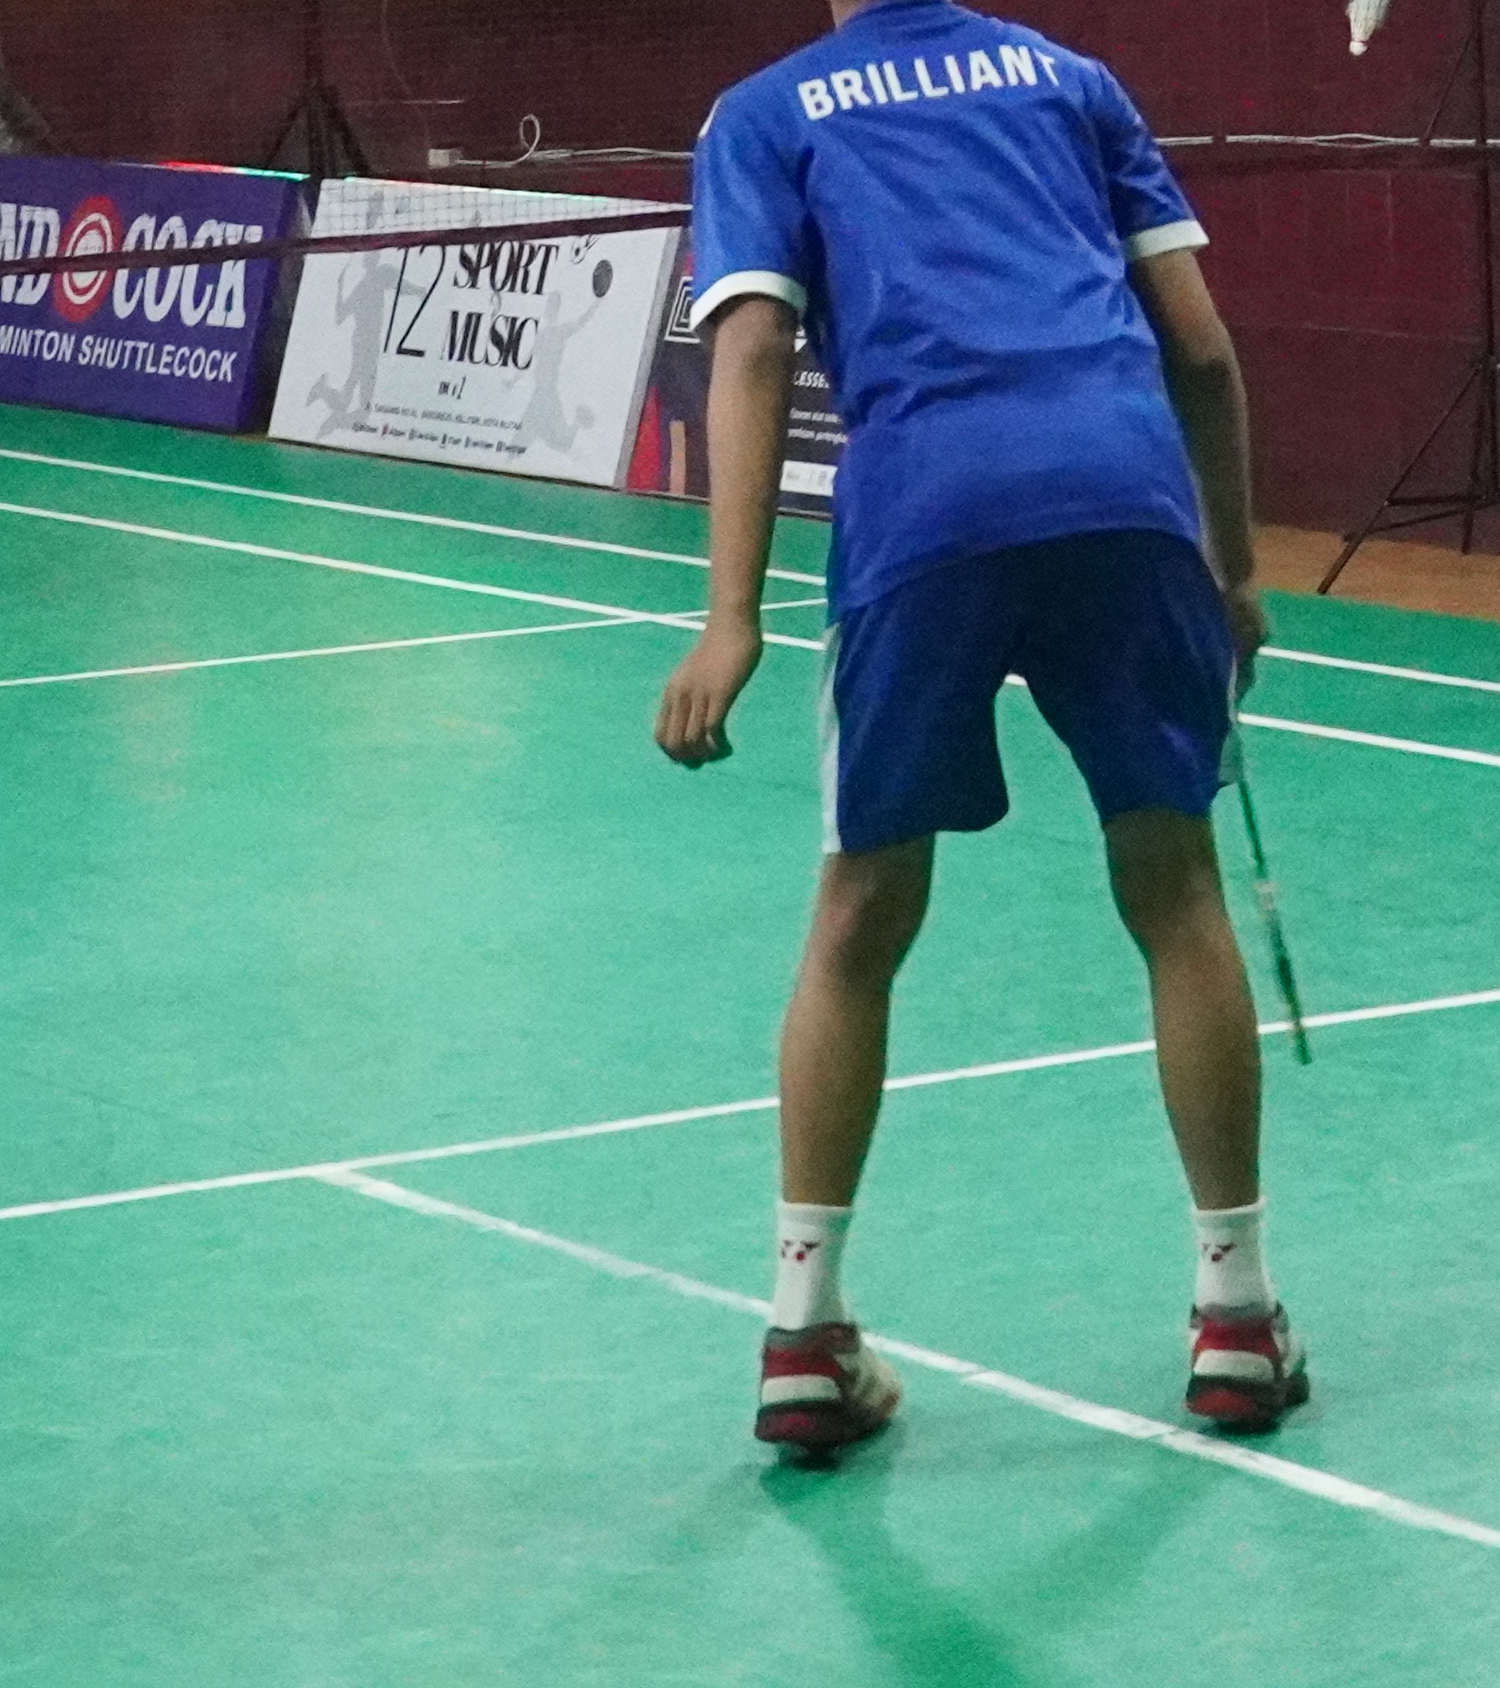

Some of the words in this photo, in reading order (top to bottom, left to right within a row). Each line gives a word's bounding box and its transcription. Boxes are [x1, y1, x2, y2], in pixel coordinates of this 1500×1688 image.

[797, 45, 1060, 121] BRILLIANT
[452, 240, 561, 296] SPORT
[78, 334, 238, 383] SHUTTLECOCK
[439, 310, 540, 371] MUSIC
